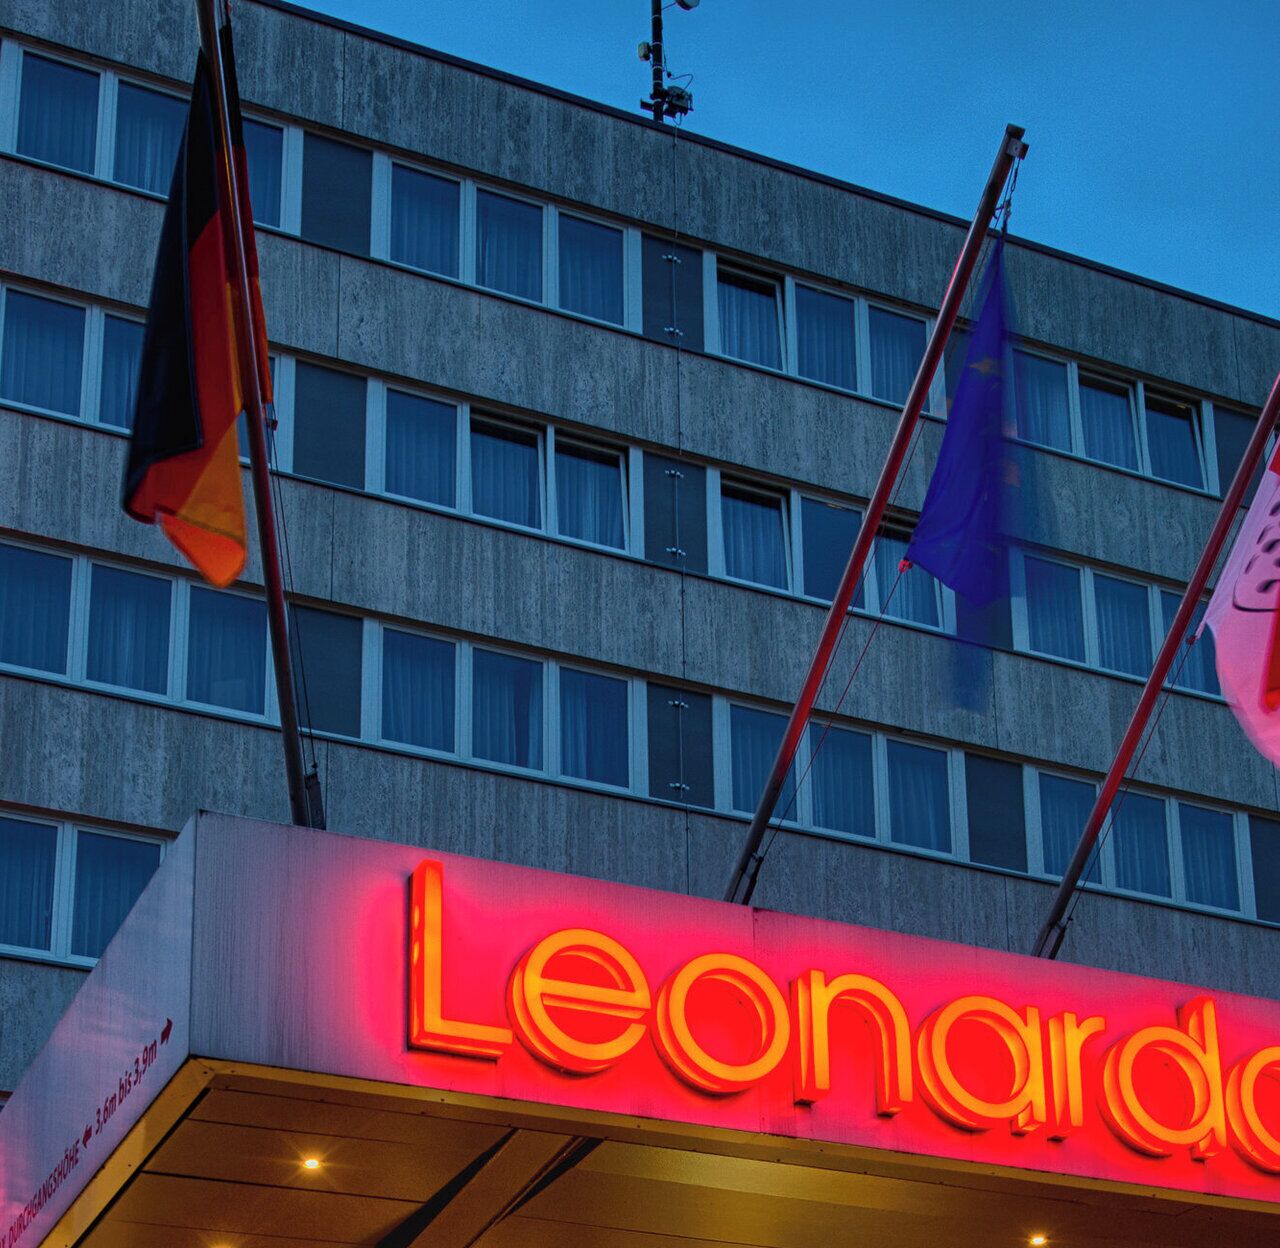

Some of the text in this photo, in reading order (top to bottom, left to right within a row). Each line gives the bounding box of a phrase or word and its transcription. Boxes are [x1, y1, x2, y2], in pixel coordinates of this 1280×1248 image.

[95, 1093, 117, 1135] 3,6m
[118, 1070, 132, 1106] bis
[133, 1039, 157, 1086] 3,9m
